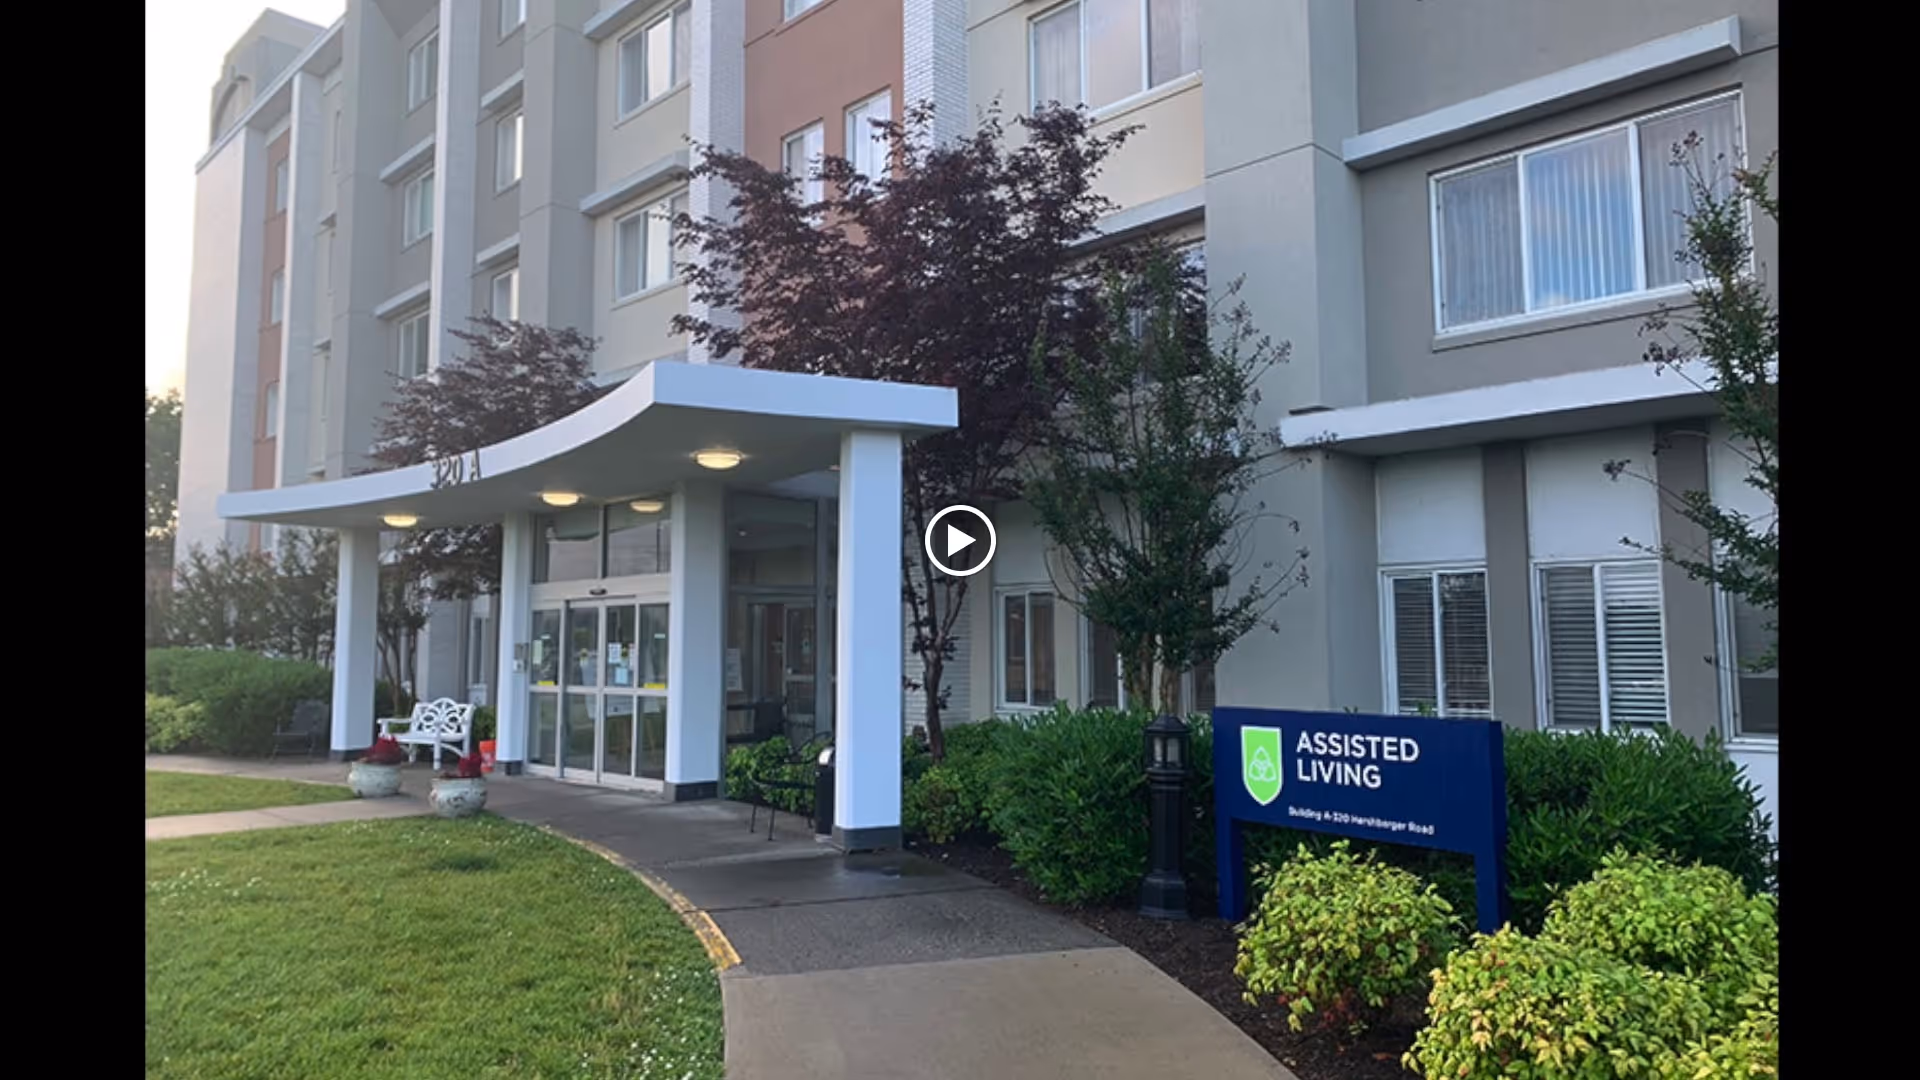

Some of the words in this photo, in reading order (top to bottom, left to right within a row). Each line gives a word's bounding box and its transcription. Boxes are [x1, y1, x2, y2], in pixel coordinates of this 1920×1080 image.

[430, 454, 464, 490] 320
[468, 449, 481, 481] A
[1296, 730, 1419, 762] ASSISTED
[1297, 758, 1382, 788] LIVING
[1288, 805, 1321, 821] Building
[1408, 821, 1434, 835] Road
